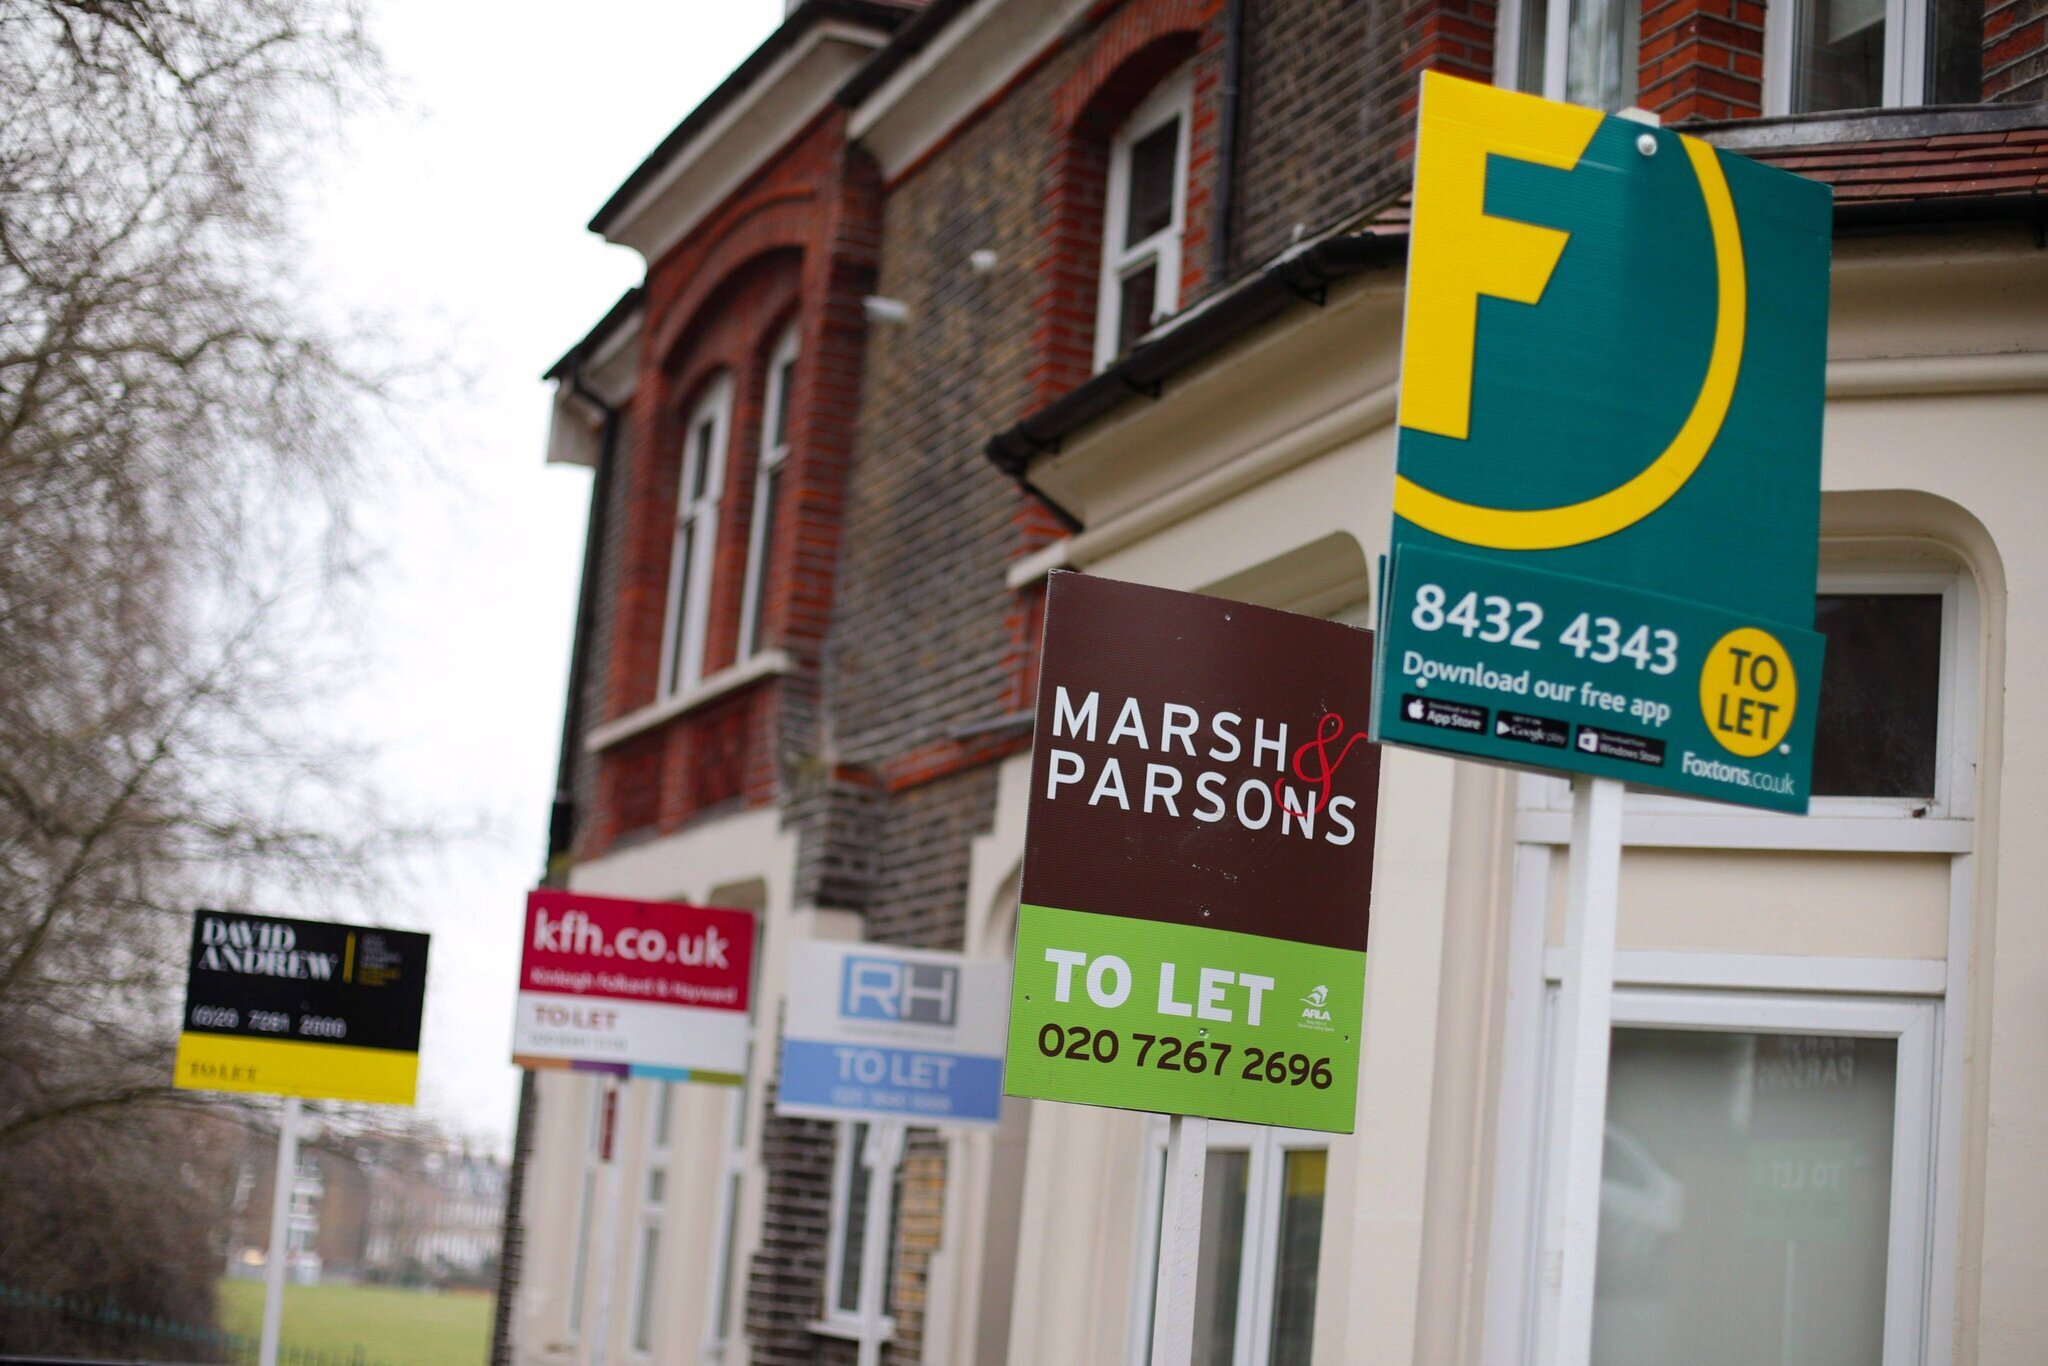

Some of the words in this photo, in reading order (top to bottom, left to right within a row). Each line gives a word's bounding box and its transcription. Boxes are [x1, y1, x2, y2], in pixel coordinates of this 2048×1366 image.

[1411, 584, 1545, 650] 8432
[1559, 613, 1680, 676] 4343
[1403, 650, 1530, 696] Download
[1534, 674, 1575, 704] our
[1580, 682, 1626, 713] free
[1630, 698, 1671, 727] app
[1728, 647, 1778, 692] TO
[1427, 710, 1450, 727] App
[1451, 713, 1481, 730] Store
[1510, 724, 1545, 743] Google
[1717, 694, 1779, 740] LET
[1052, 686, 1288, 772] MARSH
[1275, 712, 1369, 817] &
[1599, 743, 1638, 760] Windows
[1639, 750, 1662, 764] Store
[1682, 751, 1795, 795] Foxtons.co.uk
[1046, 749, 1357, 846] PARSONS
[201, 917, 297, 951] DAVID
[532, 906, 730, 970] kfh.co.uk
[198, 944, 341, 982] ANDREW
[847, 958, 954, 1022] RH
[1044, 947, 1132, 1009] TO
[1157, 962, 1275, 1027] LET
[533, 1003, 570, 1028] TO
[571, 1007, 620, 1031] LET
[1301, 1008, 1331, 1021] ARLA
[834, 1047, 887, 1085] TO
[889, 1051, 957, 1089] LET
[1038, 1023, 1119, 1064] 020
[1132, 1033, 1231, 1077] 7267
[1242, 1047, 1333, 1090] 2696
